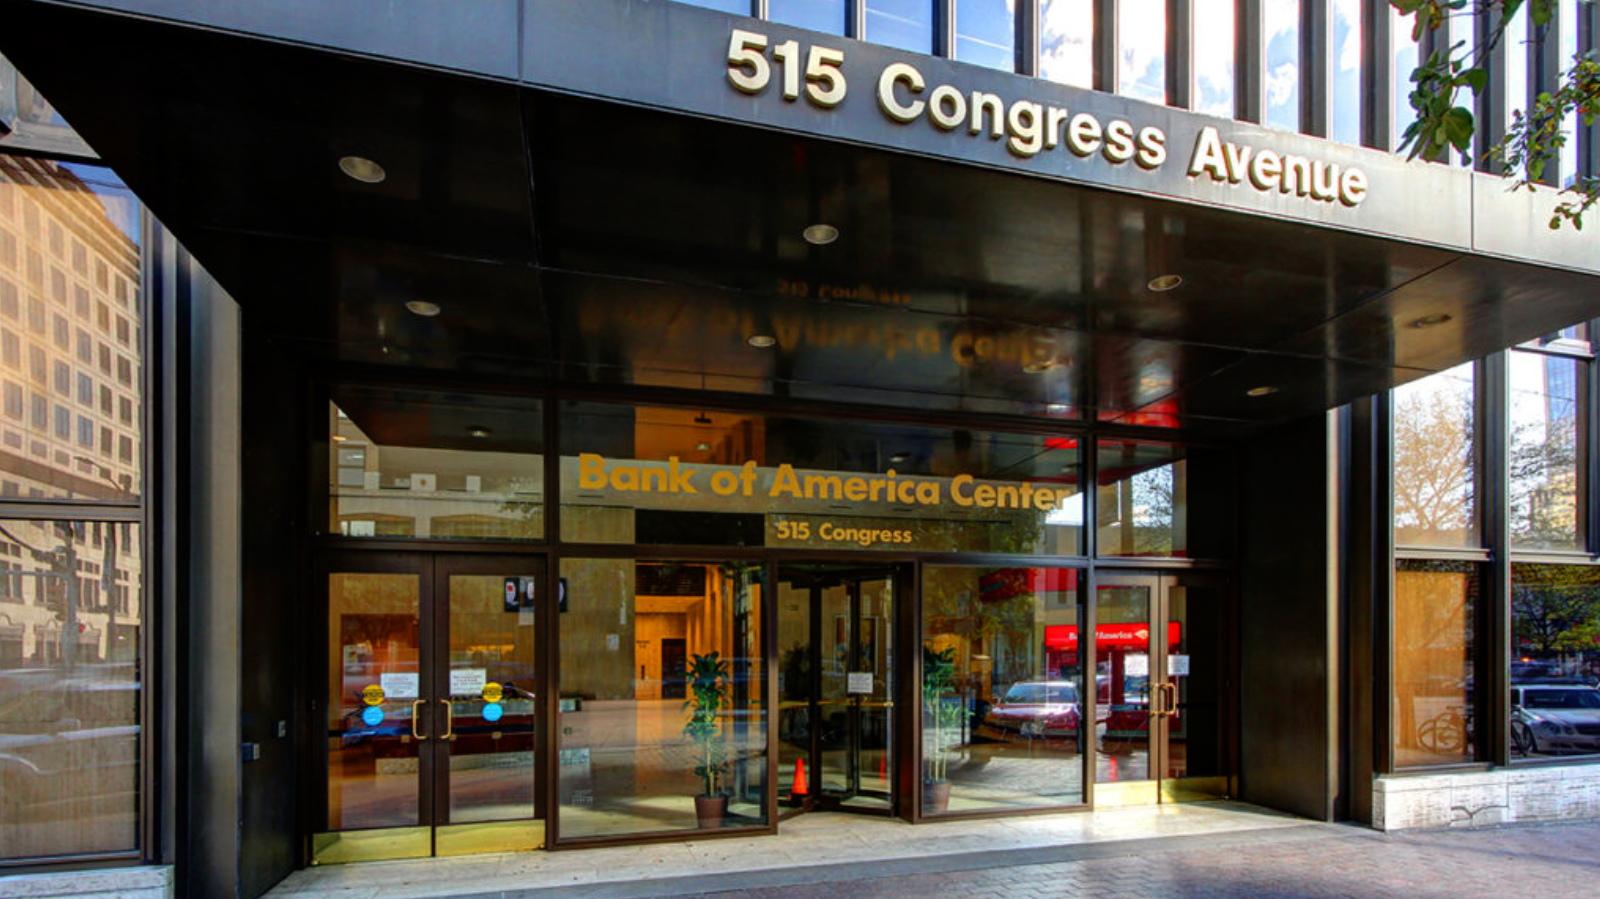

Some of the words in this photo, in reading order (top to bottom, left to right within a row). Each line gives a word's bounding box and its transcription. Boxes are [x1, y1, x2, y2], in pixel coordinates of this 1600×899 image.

[728, 29, 847, 107] 515
[878, 62, 1167, 169] Congress
[1187, 126, 1368, 207] Avenue
[579, 453, 698, 494] Bank
[710, 460, 757, 496] of
[769, 463, 940, 505] America
[951, 474, 1072, 511] Center
[776, 521, 810, 540] 515
[819, 522, 912, 546] Congress
